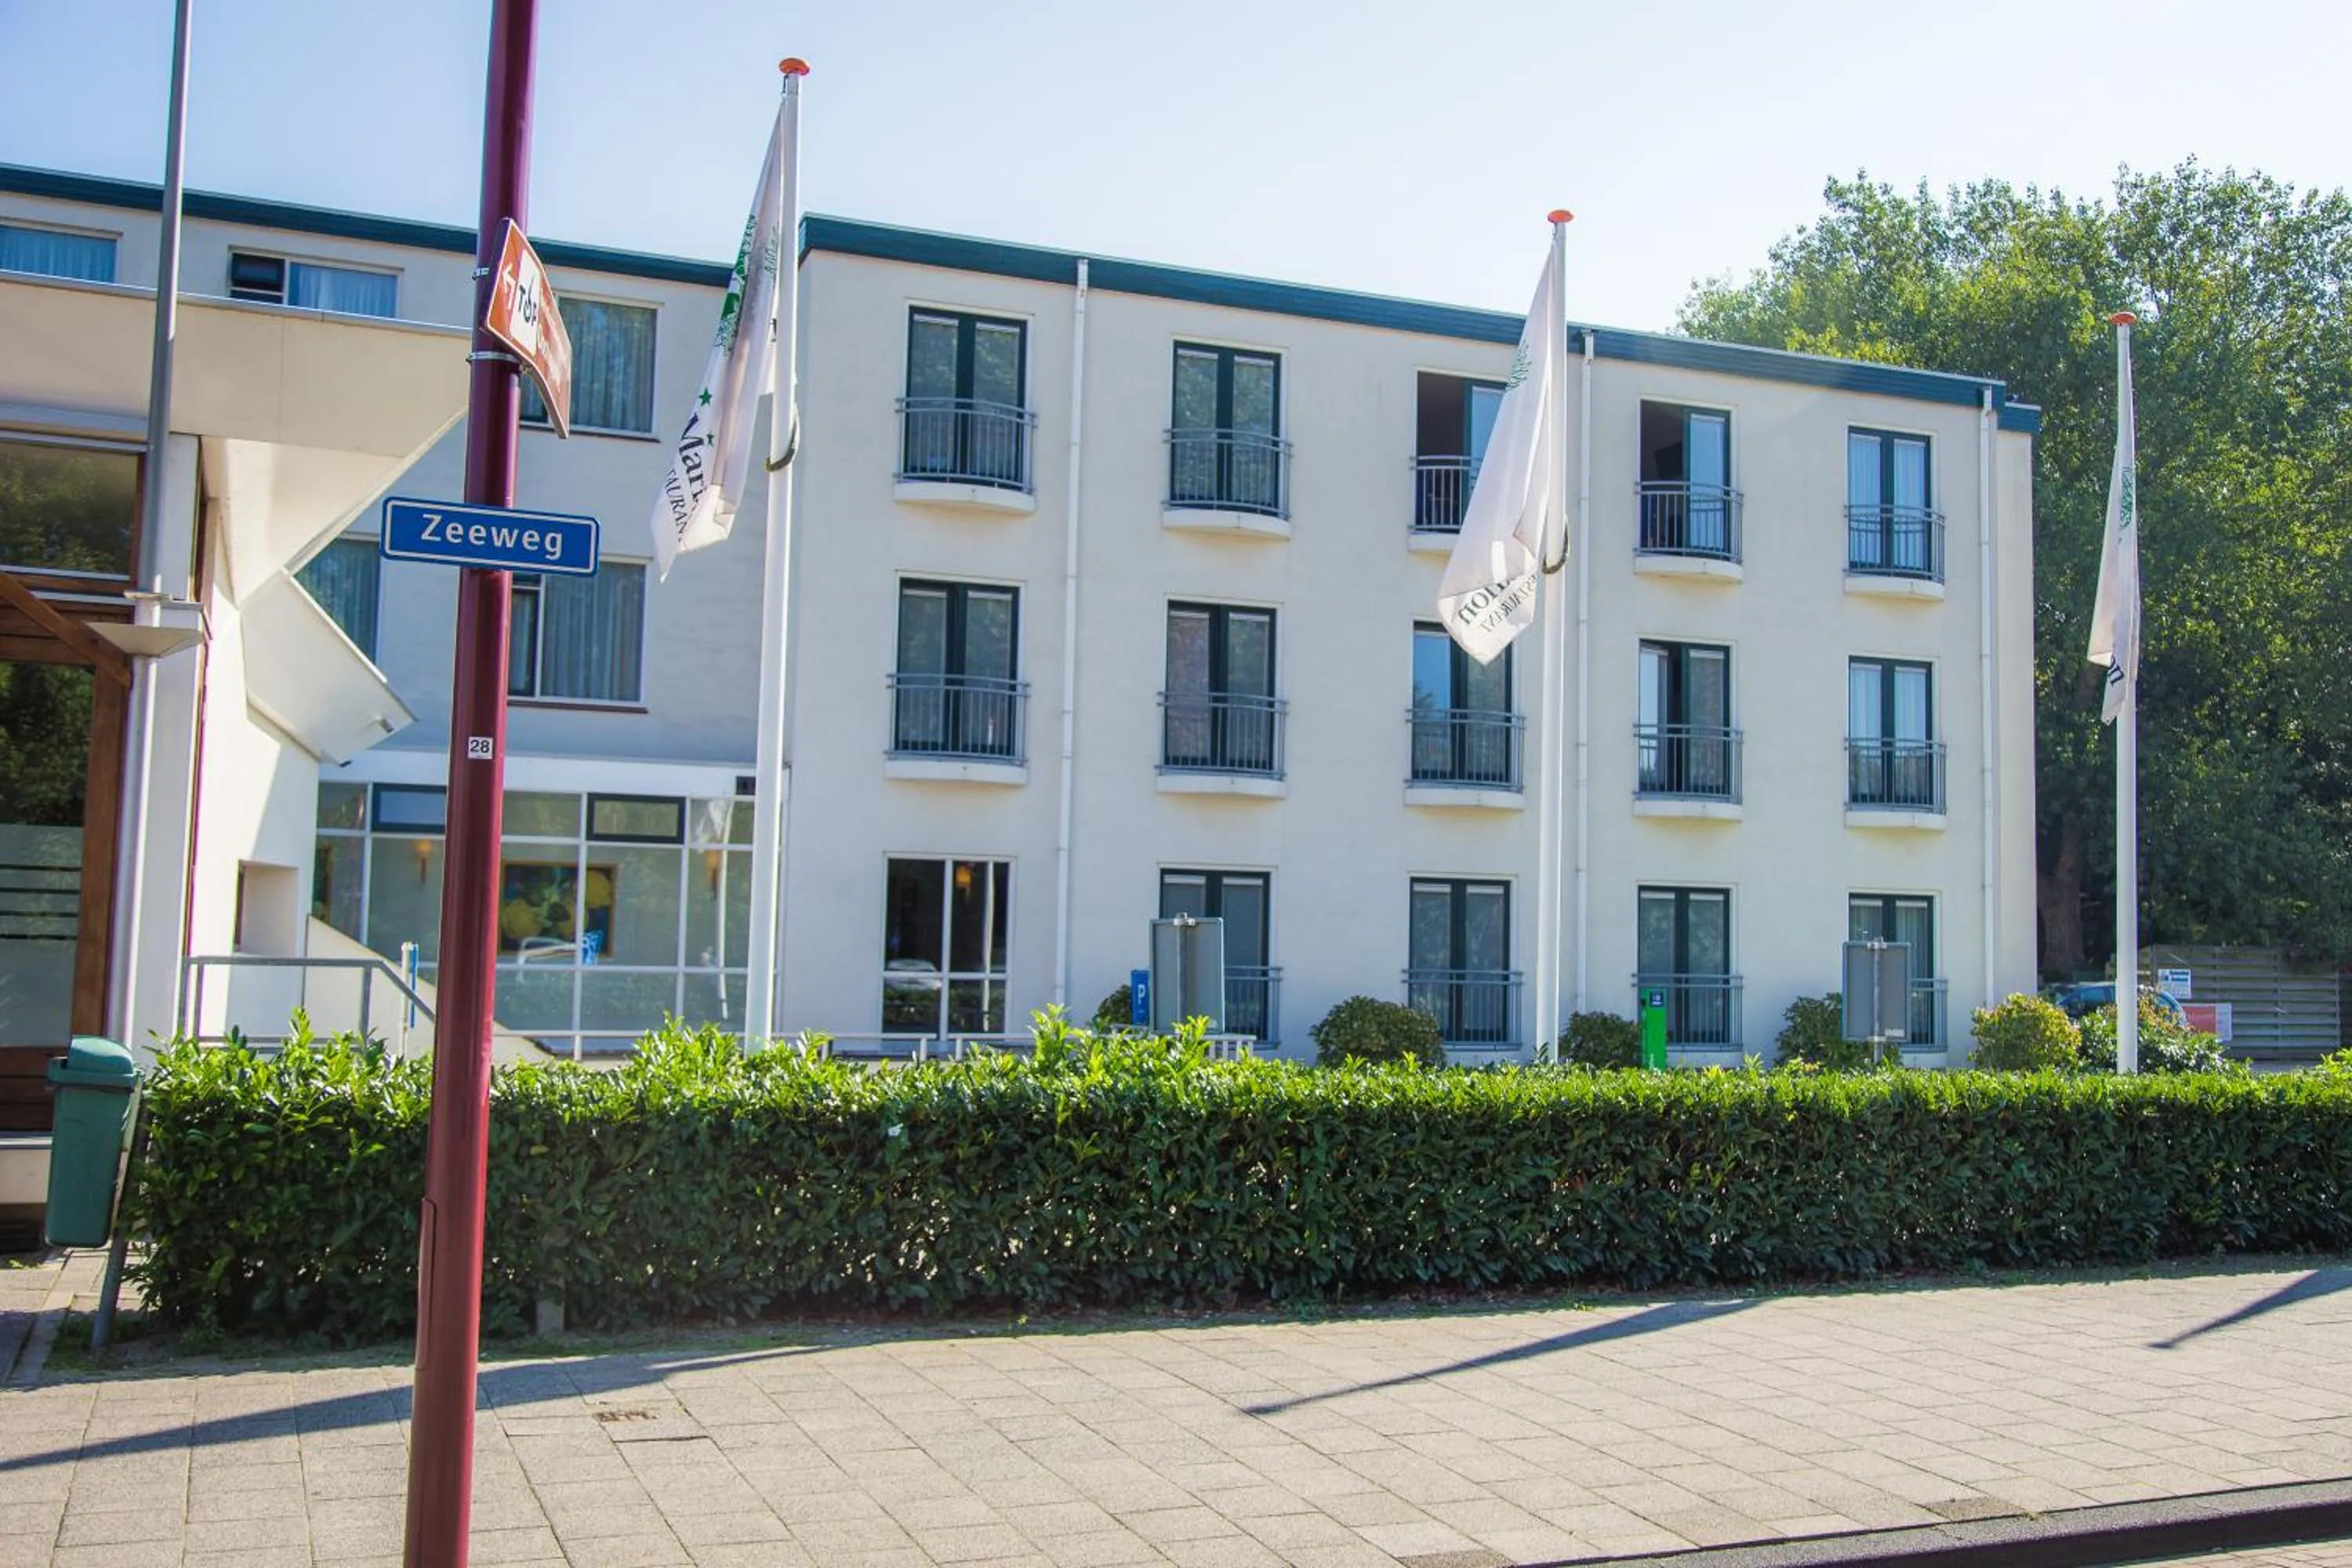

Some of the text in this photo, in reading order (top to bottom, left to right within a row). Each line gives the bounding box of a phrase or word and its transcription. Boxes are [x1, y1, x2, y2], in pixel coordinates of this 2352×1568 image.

[420, 514, 562, 560] Zeeweg
[470, 739, 489, 753] 28
[1138, 984, 1146, 1004] P
